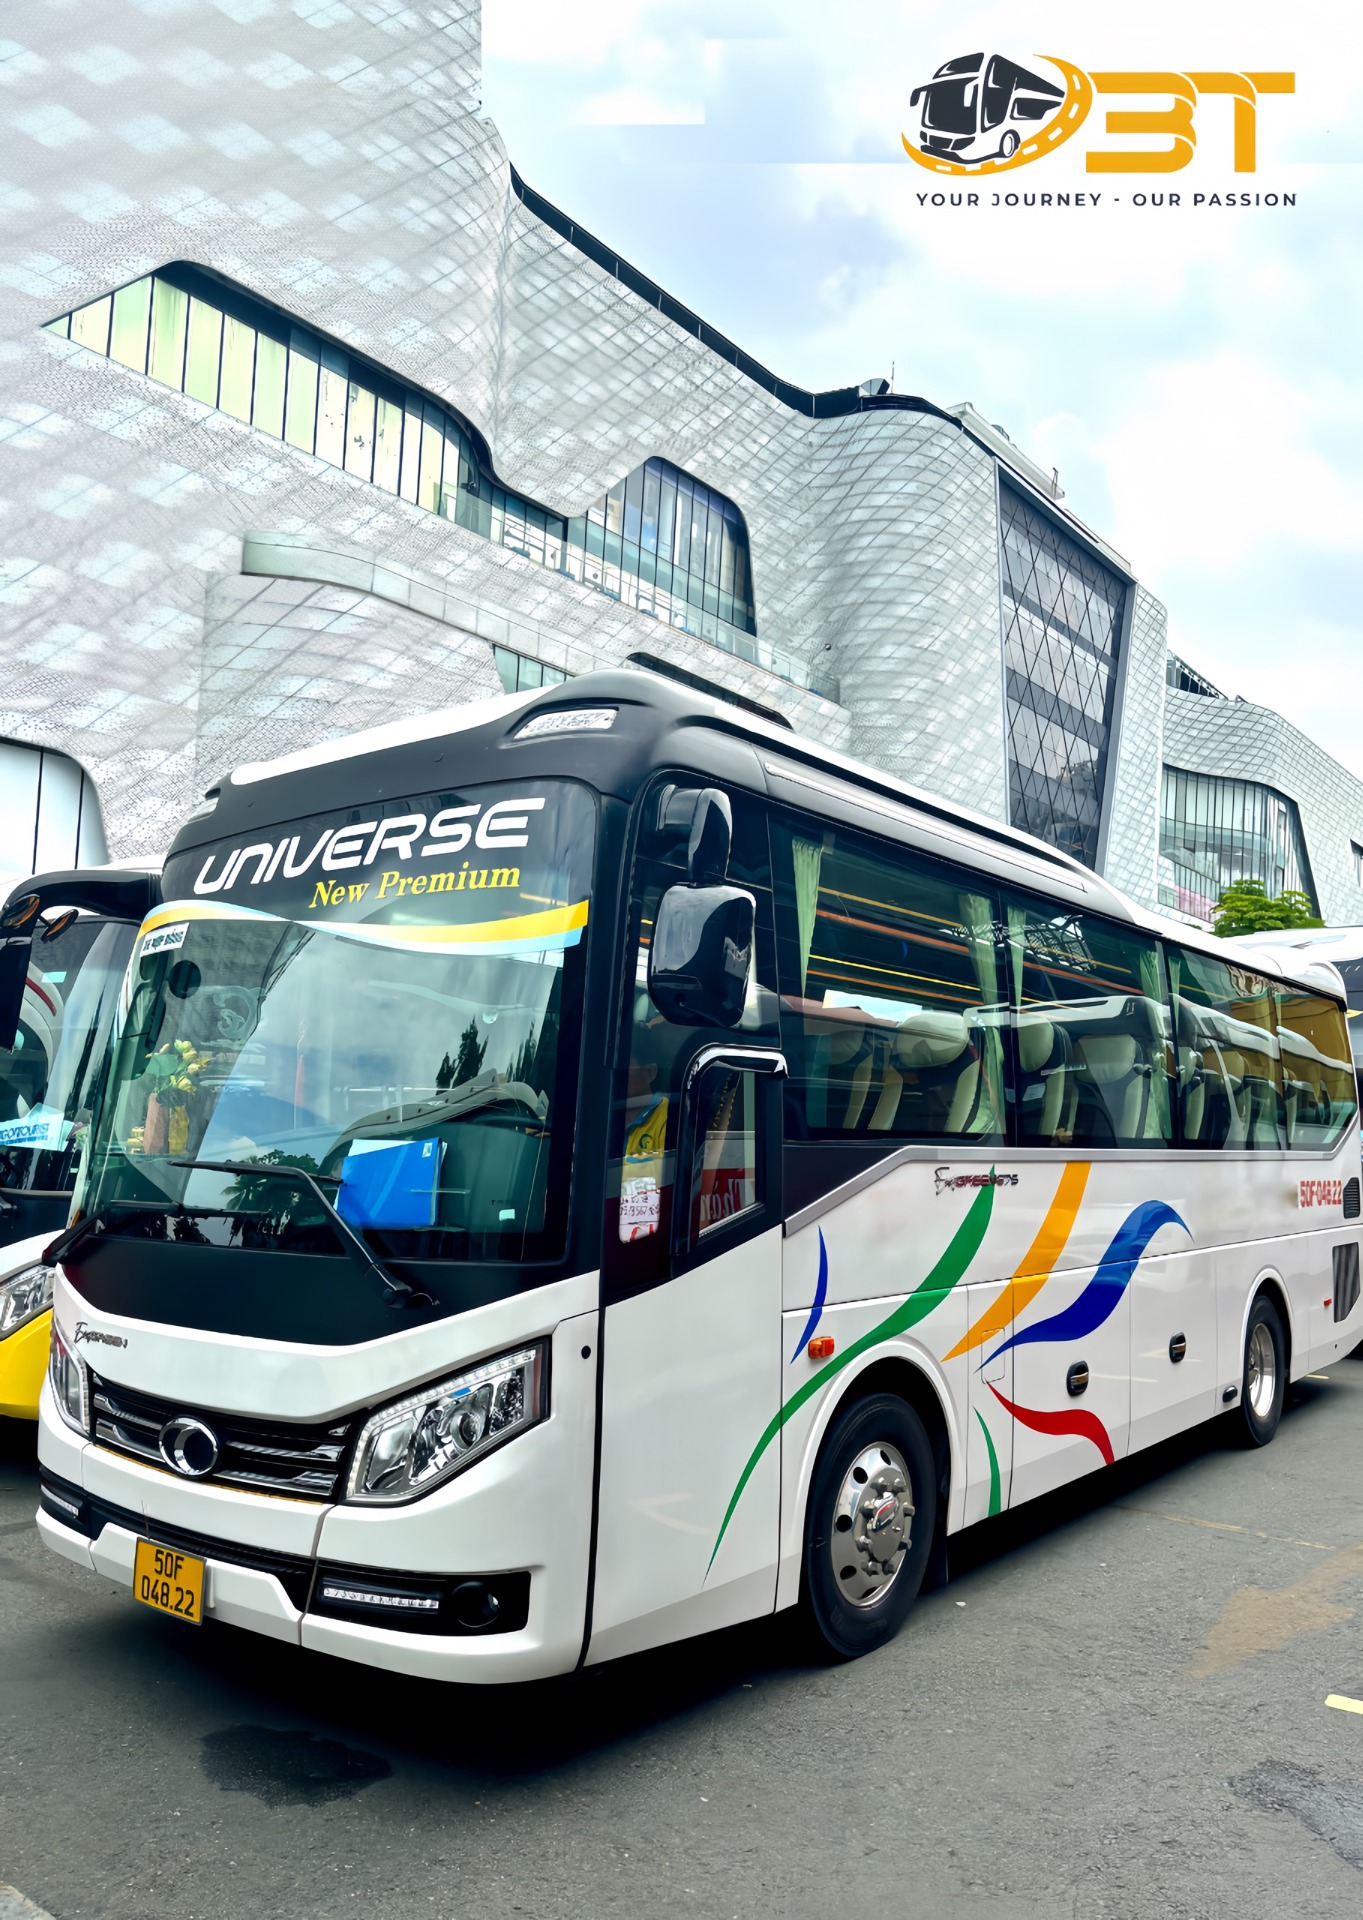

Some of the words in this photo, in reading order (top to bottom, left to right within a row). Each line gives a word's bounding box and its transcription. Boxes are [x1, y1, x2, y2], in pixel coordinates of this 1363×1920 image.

[193, 797, 546, 895] UNIVERSE
[309, 880, 371, 909] New
[374, 862, 520, 899] Premium
[154, 1549, 184, 1581] 50F
[141, 1574, 194, 1618] 048.22
